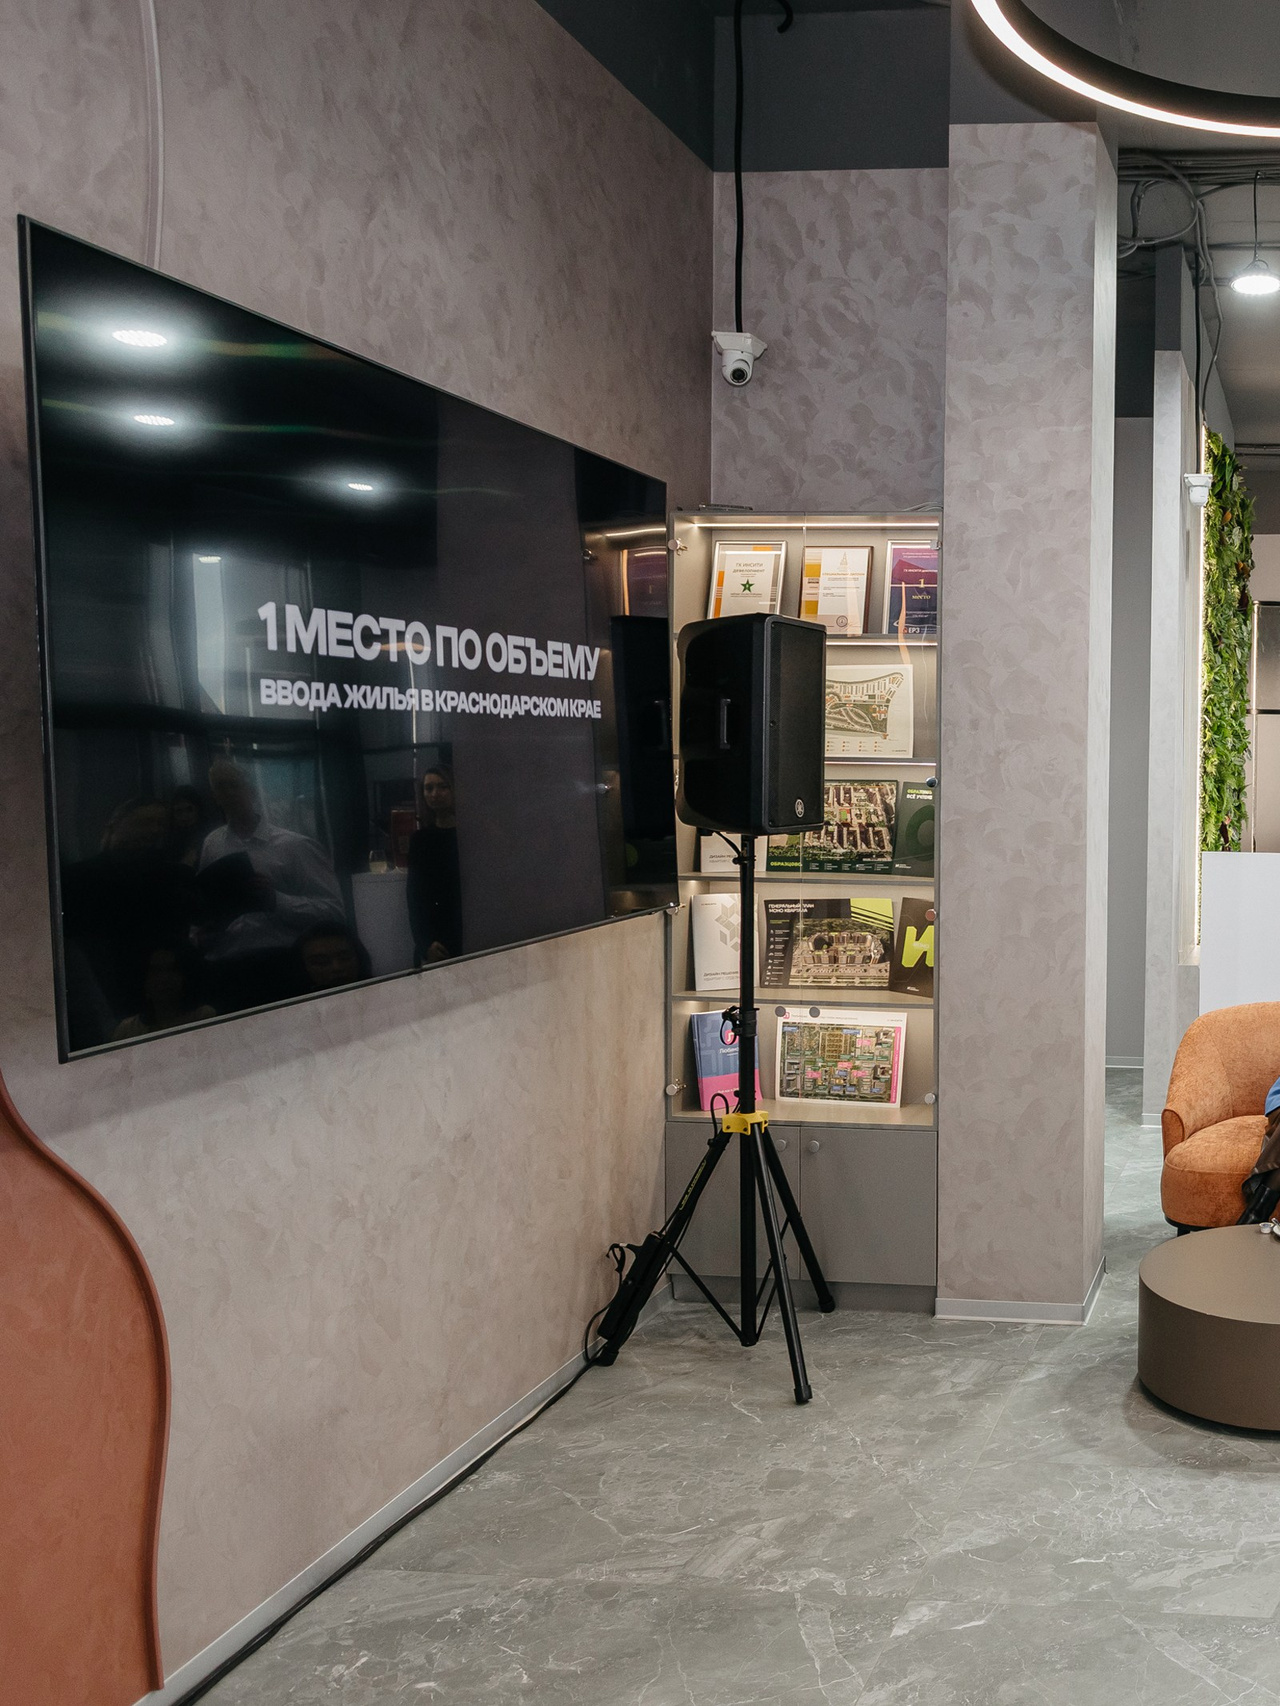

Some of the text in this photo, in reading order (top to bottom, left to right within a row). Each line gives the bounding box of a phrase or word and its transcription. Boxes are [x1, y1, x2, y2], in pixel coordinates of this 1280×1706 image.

[257, 601, 601, 681] 1 МЕСТО ПО ОБЪЕМУ
[260, 678, 602, 719] ВВОДА ЖИЛЬЯ В КРАСНОДАРСКОМ КРАЕ
